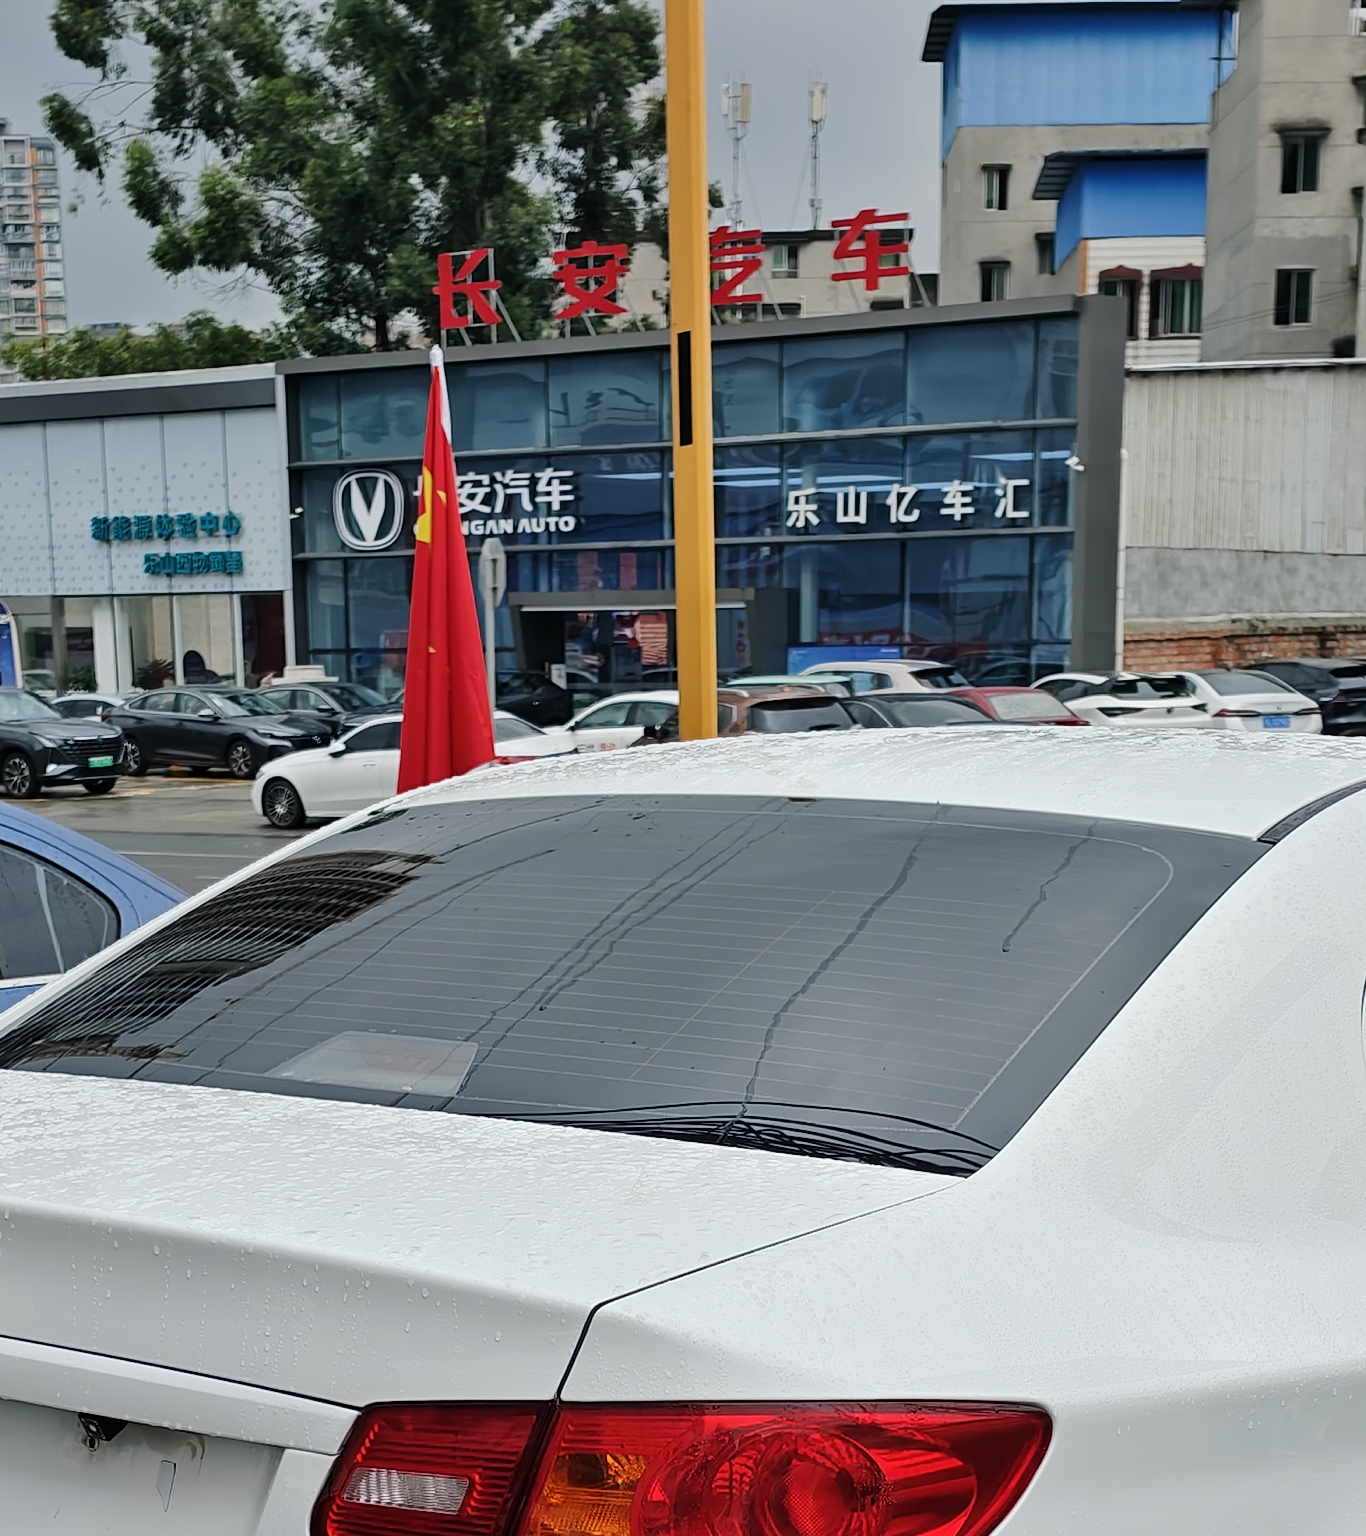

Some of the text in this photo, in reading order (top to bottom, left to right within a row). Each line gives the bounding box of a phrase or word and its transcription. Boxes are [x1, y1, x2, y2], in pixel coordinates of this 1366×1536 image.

[413, 468, 575, 514] 安汽车
[786, 477, 1030, 528] 乐山亿车汇
[91, 511, 241, 541] 新能源体验中心
[516, 516, 576, 533] AUTO
